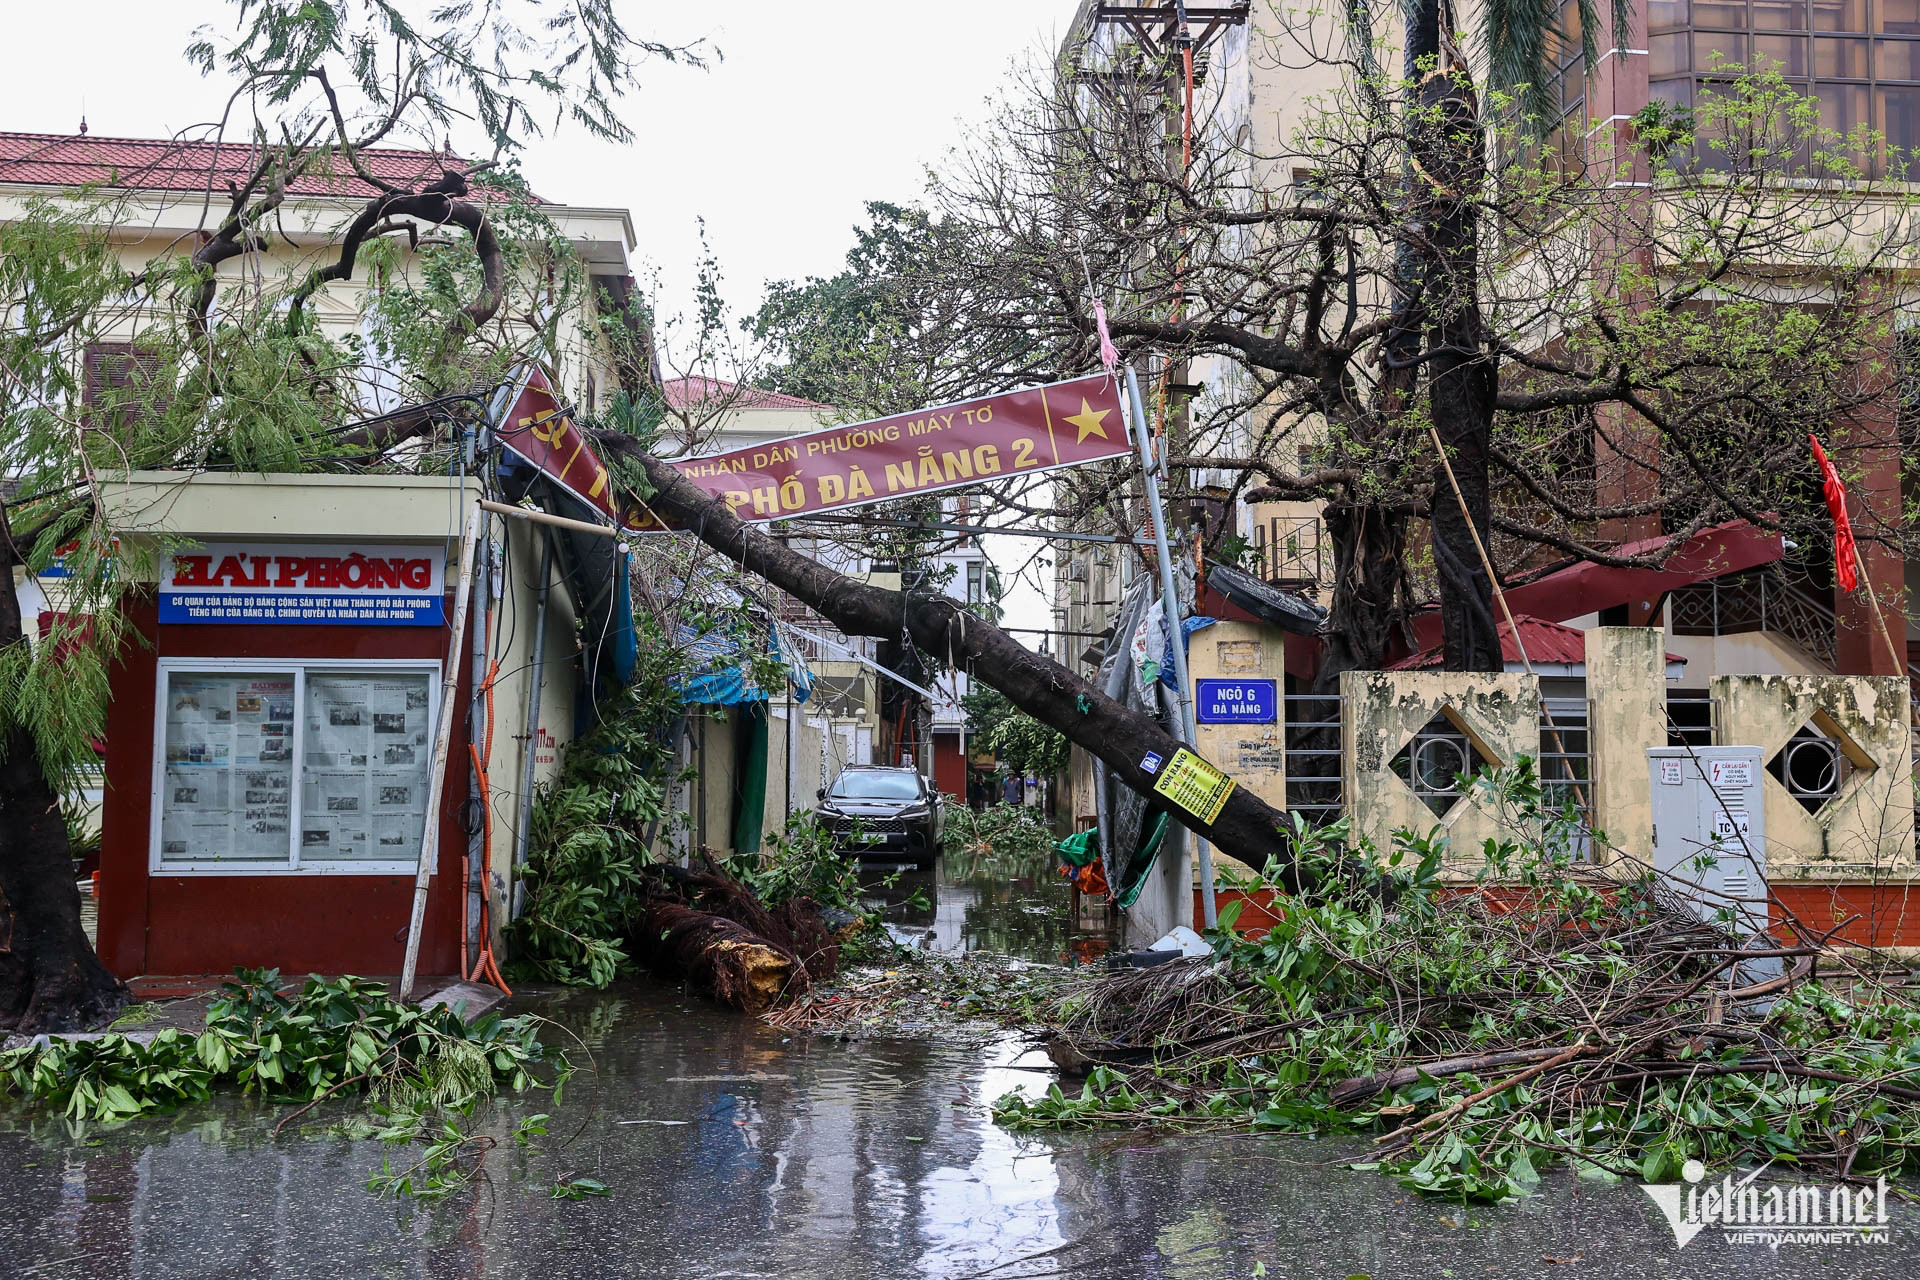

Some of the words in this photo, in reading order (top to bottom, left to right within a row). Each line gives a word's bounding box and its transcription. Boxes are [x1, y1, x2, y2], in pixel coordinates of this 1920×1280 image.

[685, 457, 746, 479] NHÂN
[754, 445, 798, 469] DÂN
[806, 425, 900, 457] PHƯỜNG
[908, 412, 954, 437] MÁY
[962, 405, 993, 425] TƠ
[724, 469, 806, 517] PHỐ
[818, 465, 875, 505] ĐÀ
[885, 445, 1001, 492] NẴNG
[1011, 438, 1038, 469] 2
[172, 596, 183, 606] CƠ
[184, 597, 204, 607] QUAN
[205, 595, 220, 606] CỦA
[244, 596, 254, 608] BỘ
[278, 596, 298, 608] CỘNG
[315, 597, 331, 609] VIỆT
[332, 598, 348, 608] NAM
[350, 597, 374, 608] THÀNH
[376, 597, 391, 608] PHỐ
[392, 597, 404, 608] HẢI
[406, 597, 431, 609] PHÒNG
[226, 607, 241, 617] CỦA
[327, 608, 337, 618] VÀ
[338, 608, 358, 619] NHÂN
[1217, 686, 1242, 700] NGÕ
[1246, 688, 1255, 701] 6
[1212, 702, 1227, 714] ĐÀ
[1231, 700, 1261, 714] NẴNG
[1144, 755, 1159, 768] 04
[1159, 774, 1173, 791] CƠM
[1171, 752, 1188, 775] RANG
[1718, 822, 1730, 833] TC
